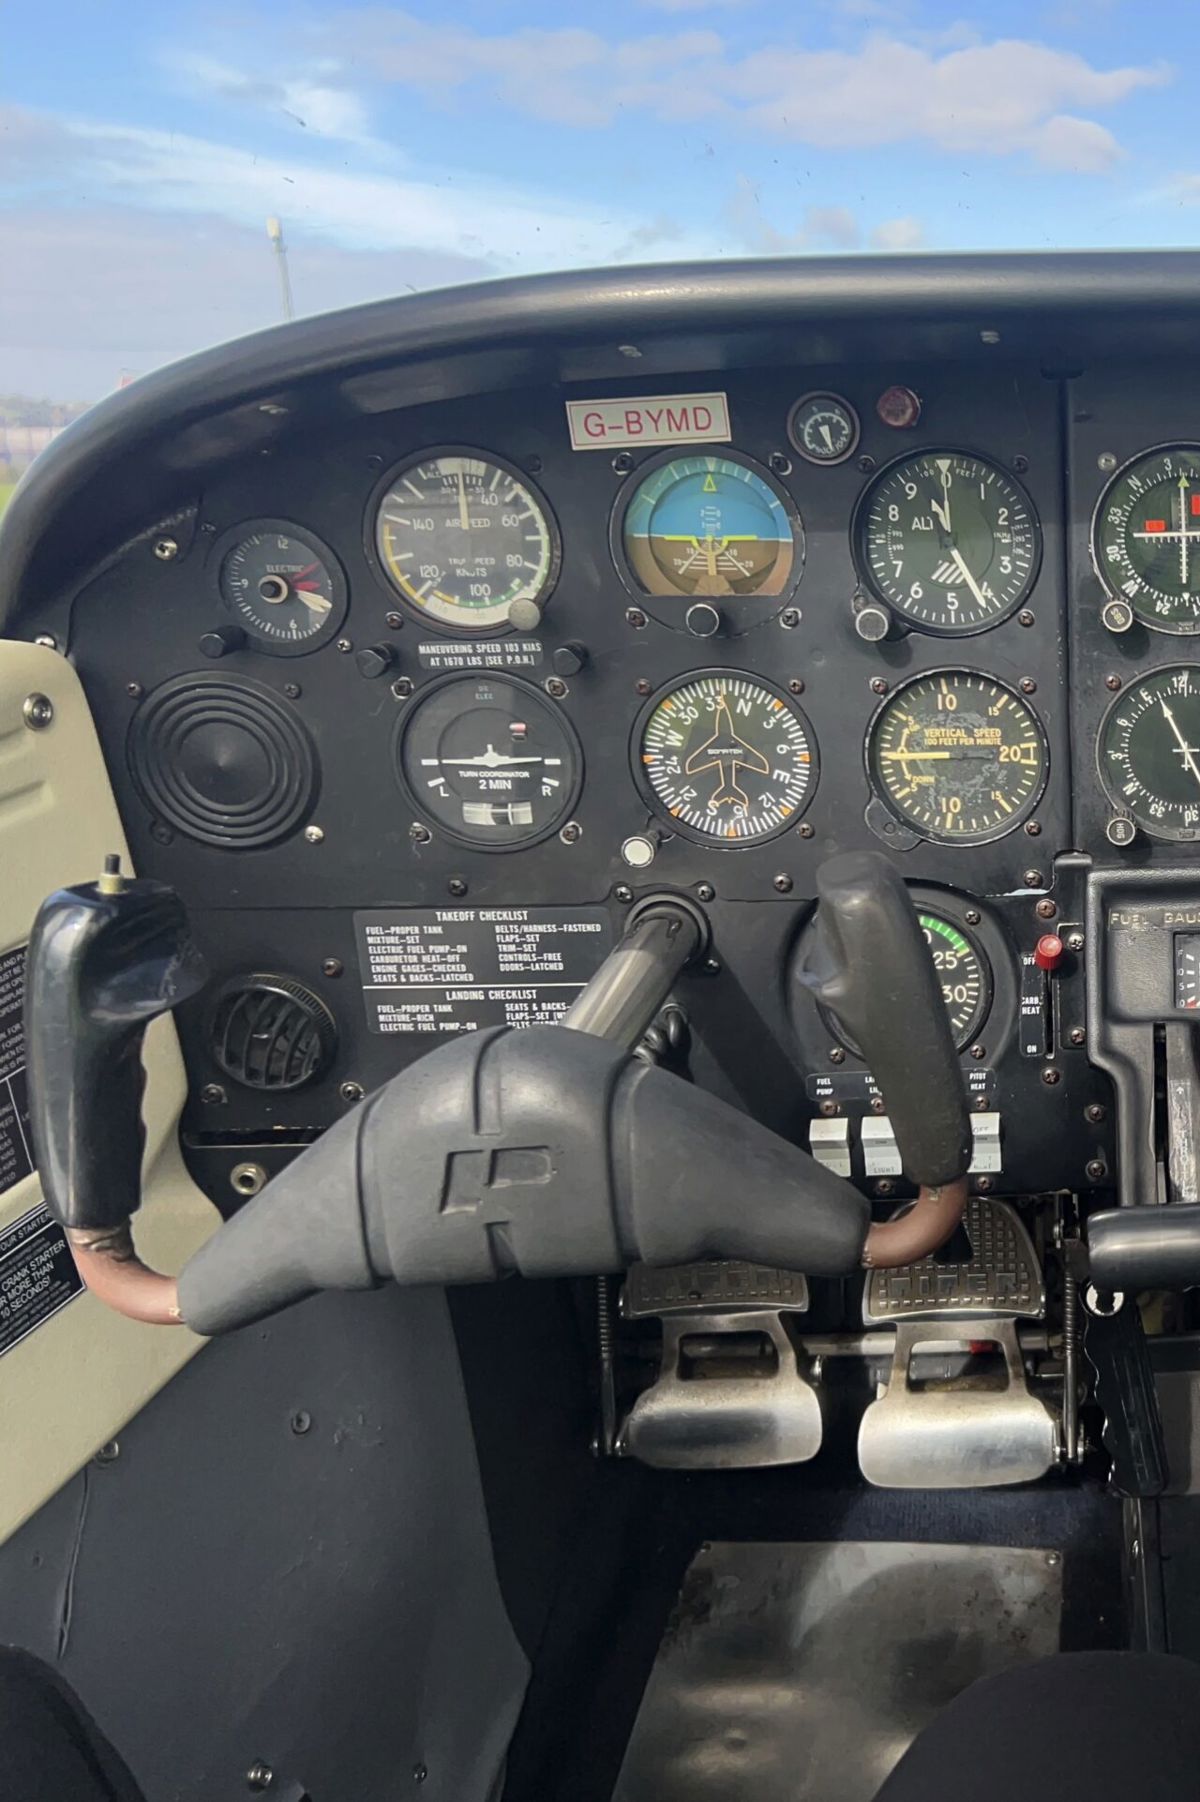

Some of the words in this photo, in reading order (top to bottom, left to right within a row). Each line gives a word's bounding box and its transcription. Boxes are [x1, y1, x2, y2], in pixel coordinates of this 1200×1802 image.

[583, 406, 712, 438] G-BYMD
[955, 467, 976, 480] FEET
[1127, 475, 1143, 491] N
[905, 482, 917, 500] 9
[888, 504, 900, 522] 8
[997, 507, 1009, 526] 2
[412, 518, 434, 531] 140
[419, 565, 439, 578] 120
[999, 556, 1012, 574] 3
[470, 584, 491, 597] 100
[910, 581, 923, 599] 6
[1121, 579, 1139, 598] W
[946, 592, 959, 610] 5
[418, 644, 474, 655] MANEUVERING
[476, 643, 501, 655] SPEED
[504, 643, 519, 653] 103
[522, 642, 542, 652] KIAS
[443, 657, 464, 666] 1670
[466, 656, 483, 667] LBS
[736, 698, 752, 717] N
[937, 694, 957, 711] 10
[923, 728, 967, 738] VERTICAL
[973, 728, 1002, 738] SPEED
[939, 738, 958, 746] FEET
[959, 738, 975, 746] PER
[976, 738, 1002, 746] MINUTE
[999, 746, 1021, 762] 20
[489, 780, 512, 790] MIN
[911, 775, 935, 784] DOWN
[941, 797, 962, 814] 10
[435, 911, 475, 921] TAKEOFF
[479, 910, 528, 921] CHECKLIST
[1111, 913, 1149, 926] FUEL
[423, 925, 443, 935] TANK
[368, 945, 404, 954] ELECTRIC
[405, 945, 426, 954] FUEL
[370, 955, 418, 964] CARBURETOR
[932, 951, 958, 970] 25
[1023, 957, 1036, 966] OFF
[371, 964, 399, 973] ENGINE
[372, 974, 397, 983] SEATS
[445, 990, 485, 1001] LANDING
[488, 990, 538, 1000] CHECKLIST
[433, 1004, 453, 1013] TANK
[505, 1003, 529, 1012] SEATS
[1021, 1006, 1041, 1015] HEAT
[380, 1023, 415, 1032] ELECTRIC
[417, 1023, 436, 1031] FUEL
[969, 1072, 986, 1080] PITOT
[816, 1088, 834, 1096] PUMP
[970, 1082, 986, 1091] HEAT
[1, 1265, 30, 1292] CRANK
[29, 1239, 66, 1271] STARTER
[7, 1276, 33, 1299] MORE
